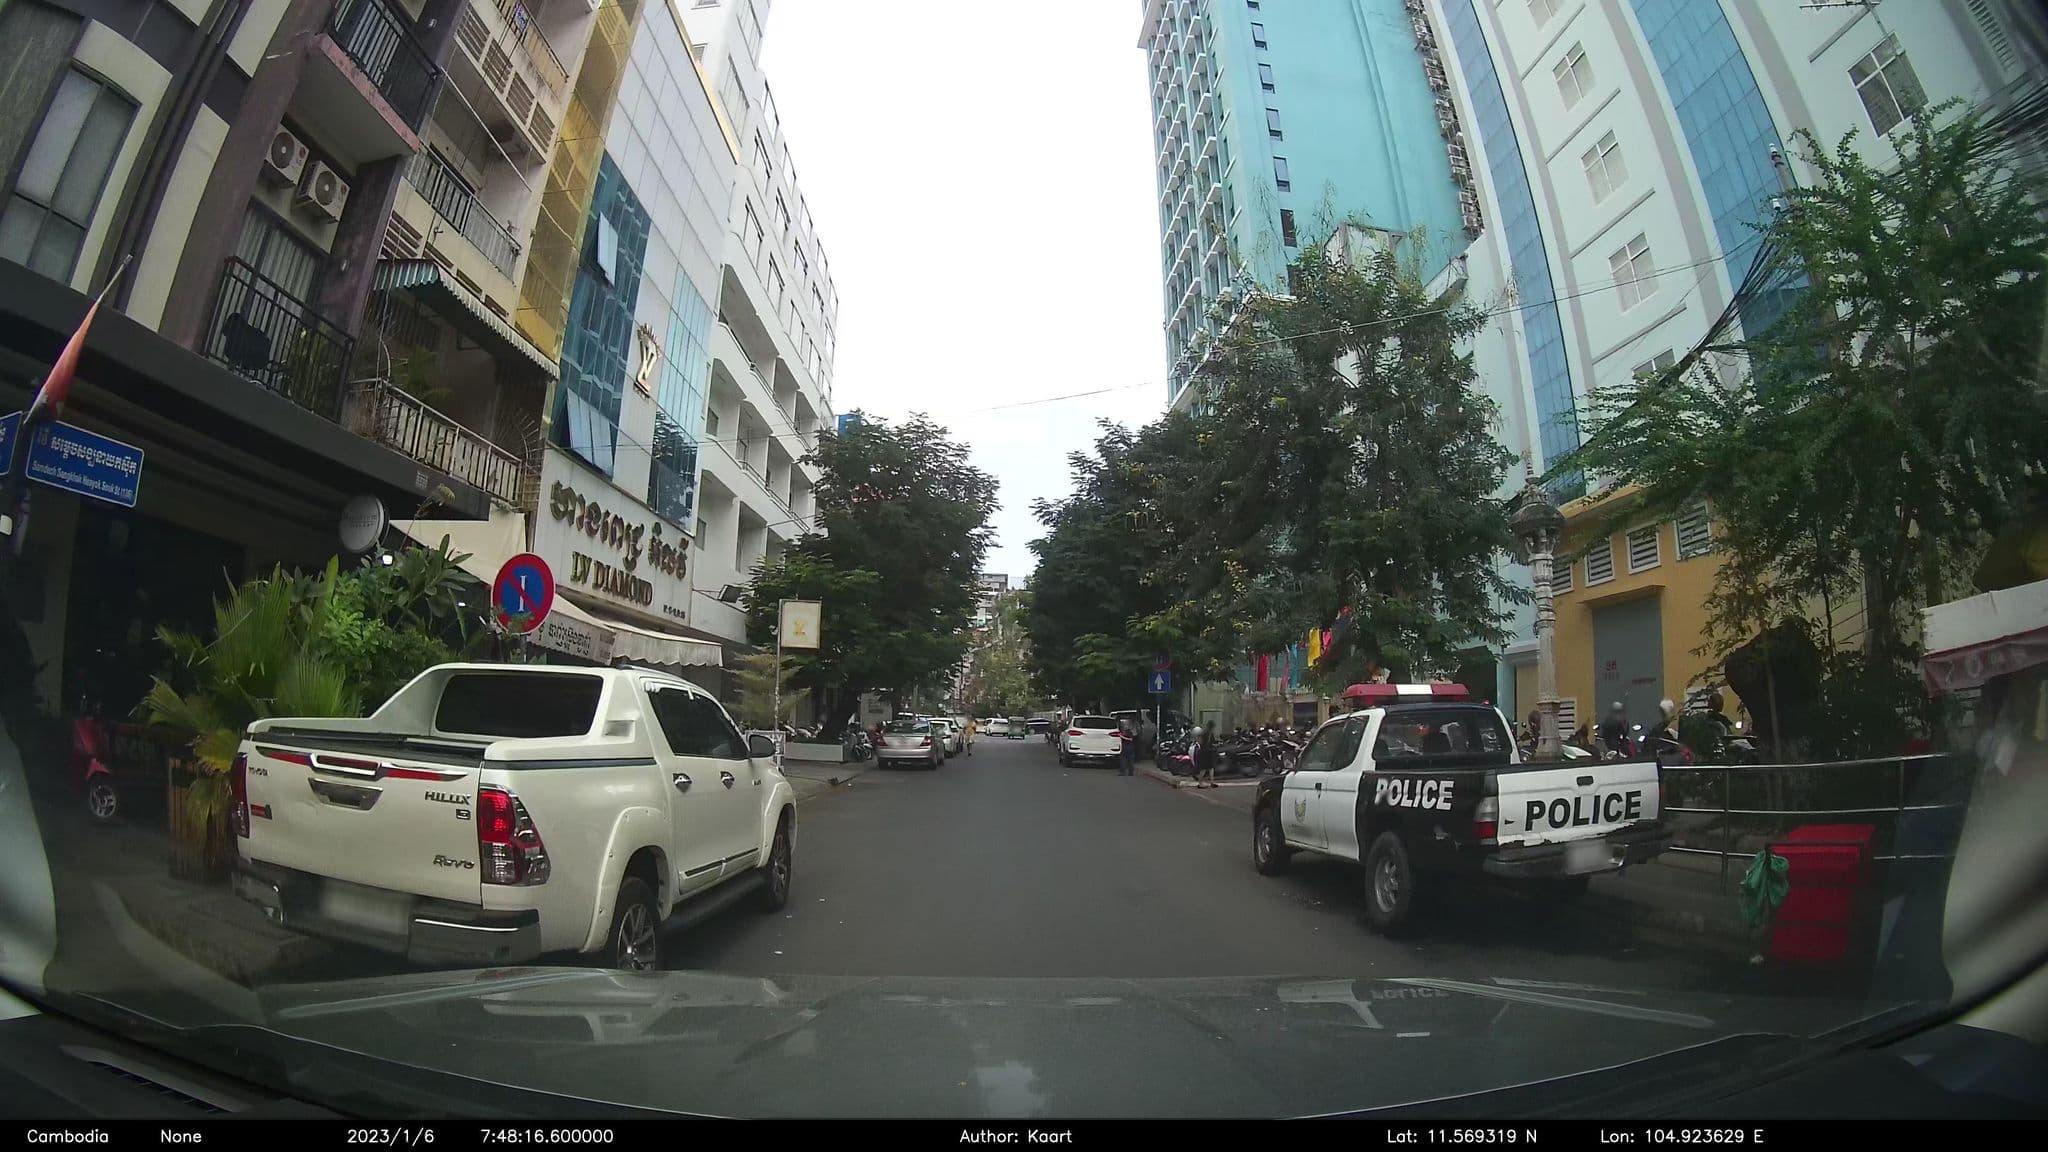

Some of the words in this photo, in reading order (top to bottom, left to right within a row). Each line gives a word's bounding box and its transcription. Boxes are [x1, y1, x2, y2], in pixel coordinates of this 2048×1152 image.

[570, 551, 593, 585] LV
[592, 560, 653, 606] DIAMOND
[425, 791, 471, 805] HILUX
[1374, 778, 1454, 811] POLICE
[1524, 790, 1642, 831] POLICE
[433, 854, 475, 869] Revo
